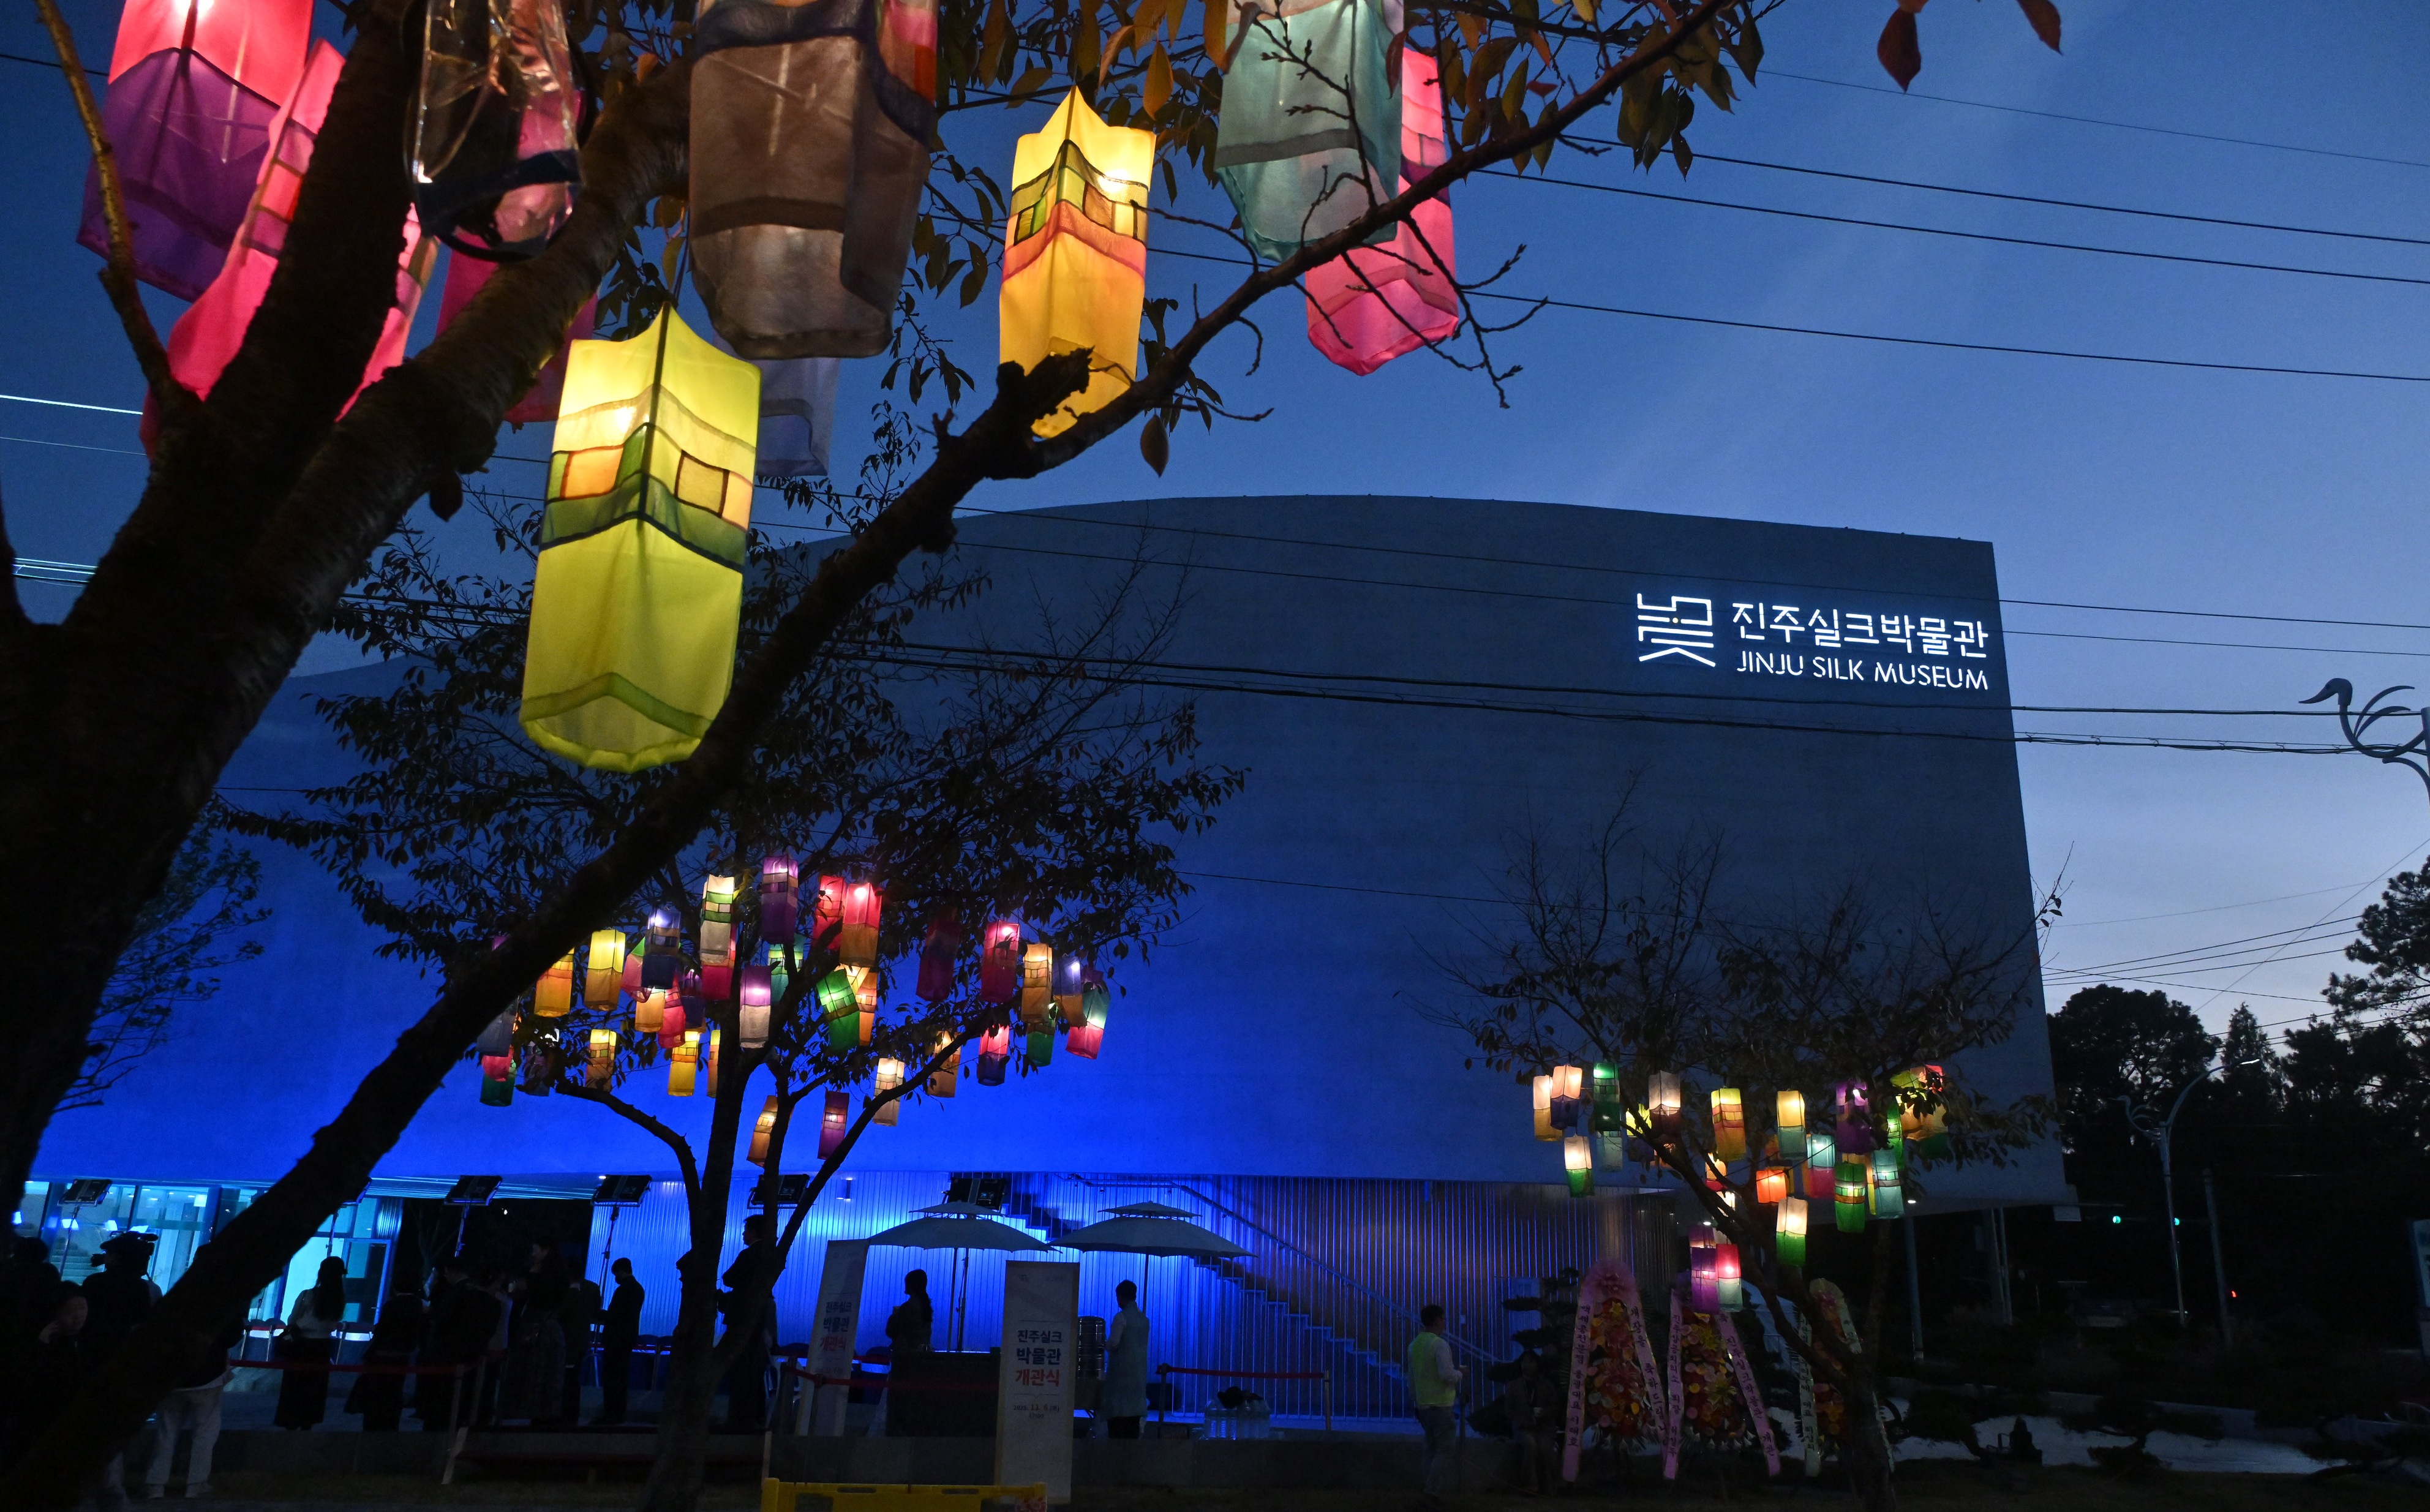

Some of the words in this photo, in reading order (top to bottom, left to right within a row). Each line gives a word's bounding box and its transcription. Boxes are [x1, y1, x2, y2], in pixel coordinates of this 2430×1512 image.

[1732, 602, 1989, 658] 진주실크박물관
[1737, 650, 1804, 676] JINJU
[1812, 656, 1865, 681] SILK
[1875, 661, 1988, 690] MUSEUM
[826, 1301, 852, 1313] 진주실크
[823, 1317, 849, 1333] 박물관
[819, 1336, 846, 1352] 개관식
[1017, 1330, 1063, 1343] 진주실크
[1017, 1347, 1061, 1365] 박물관
[1015, 1368, 1060, 1387] 개관식
